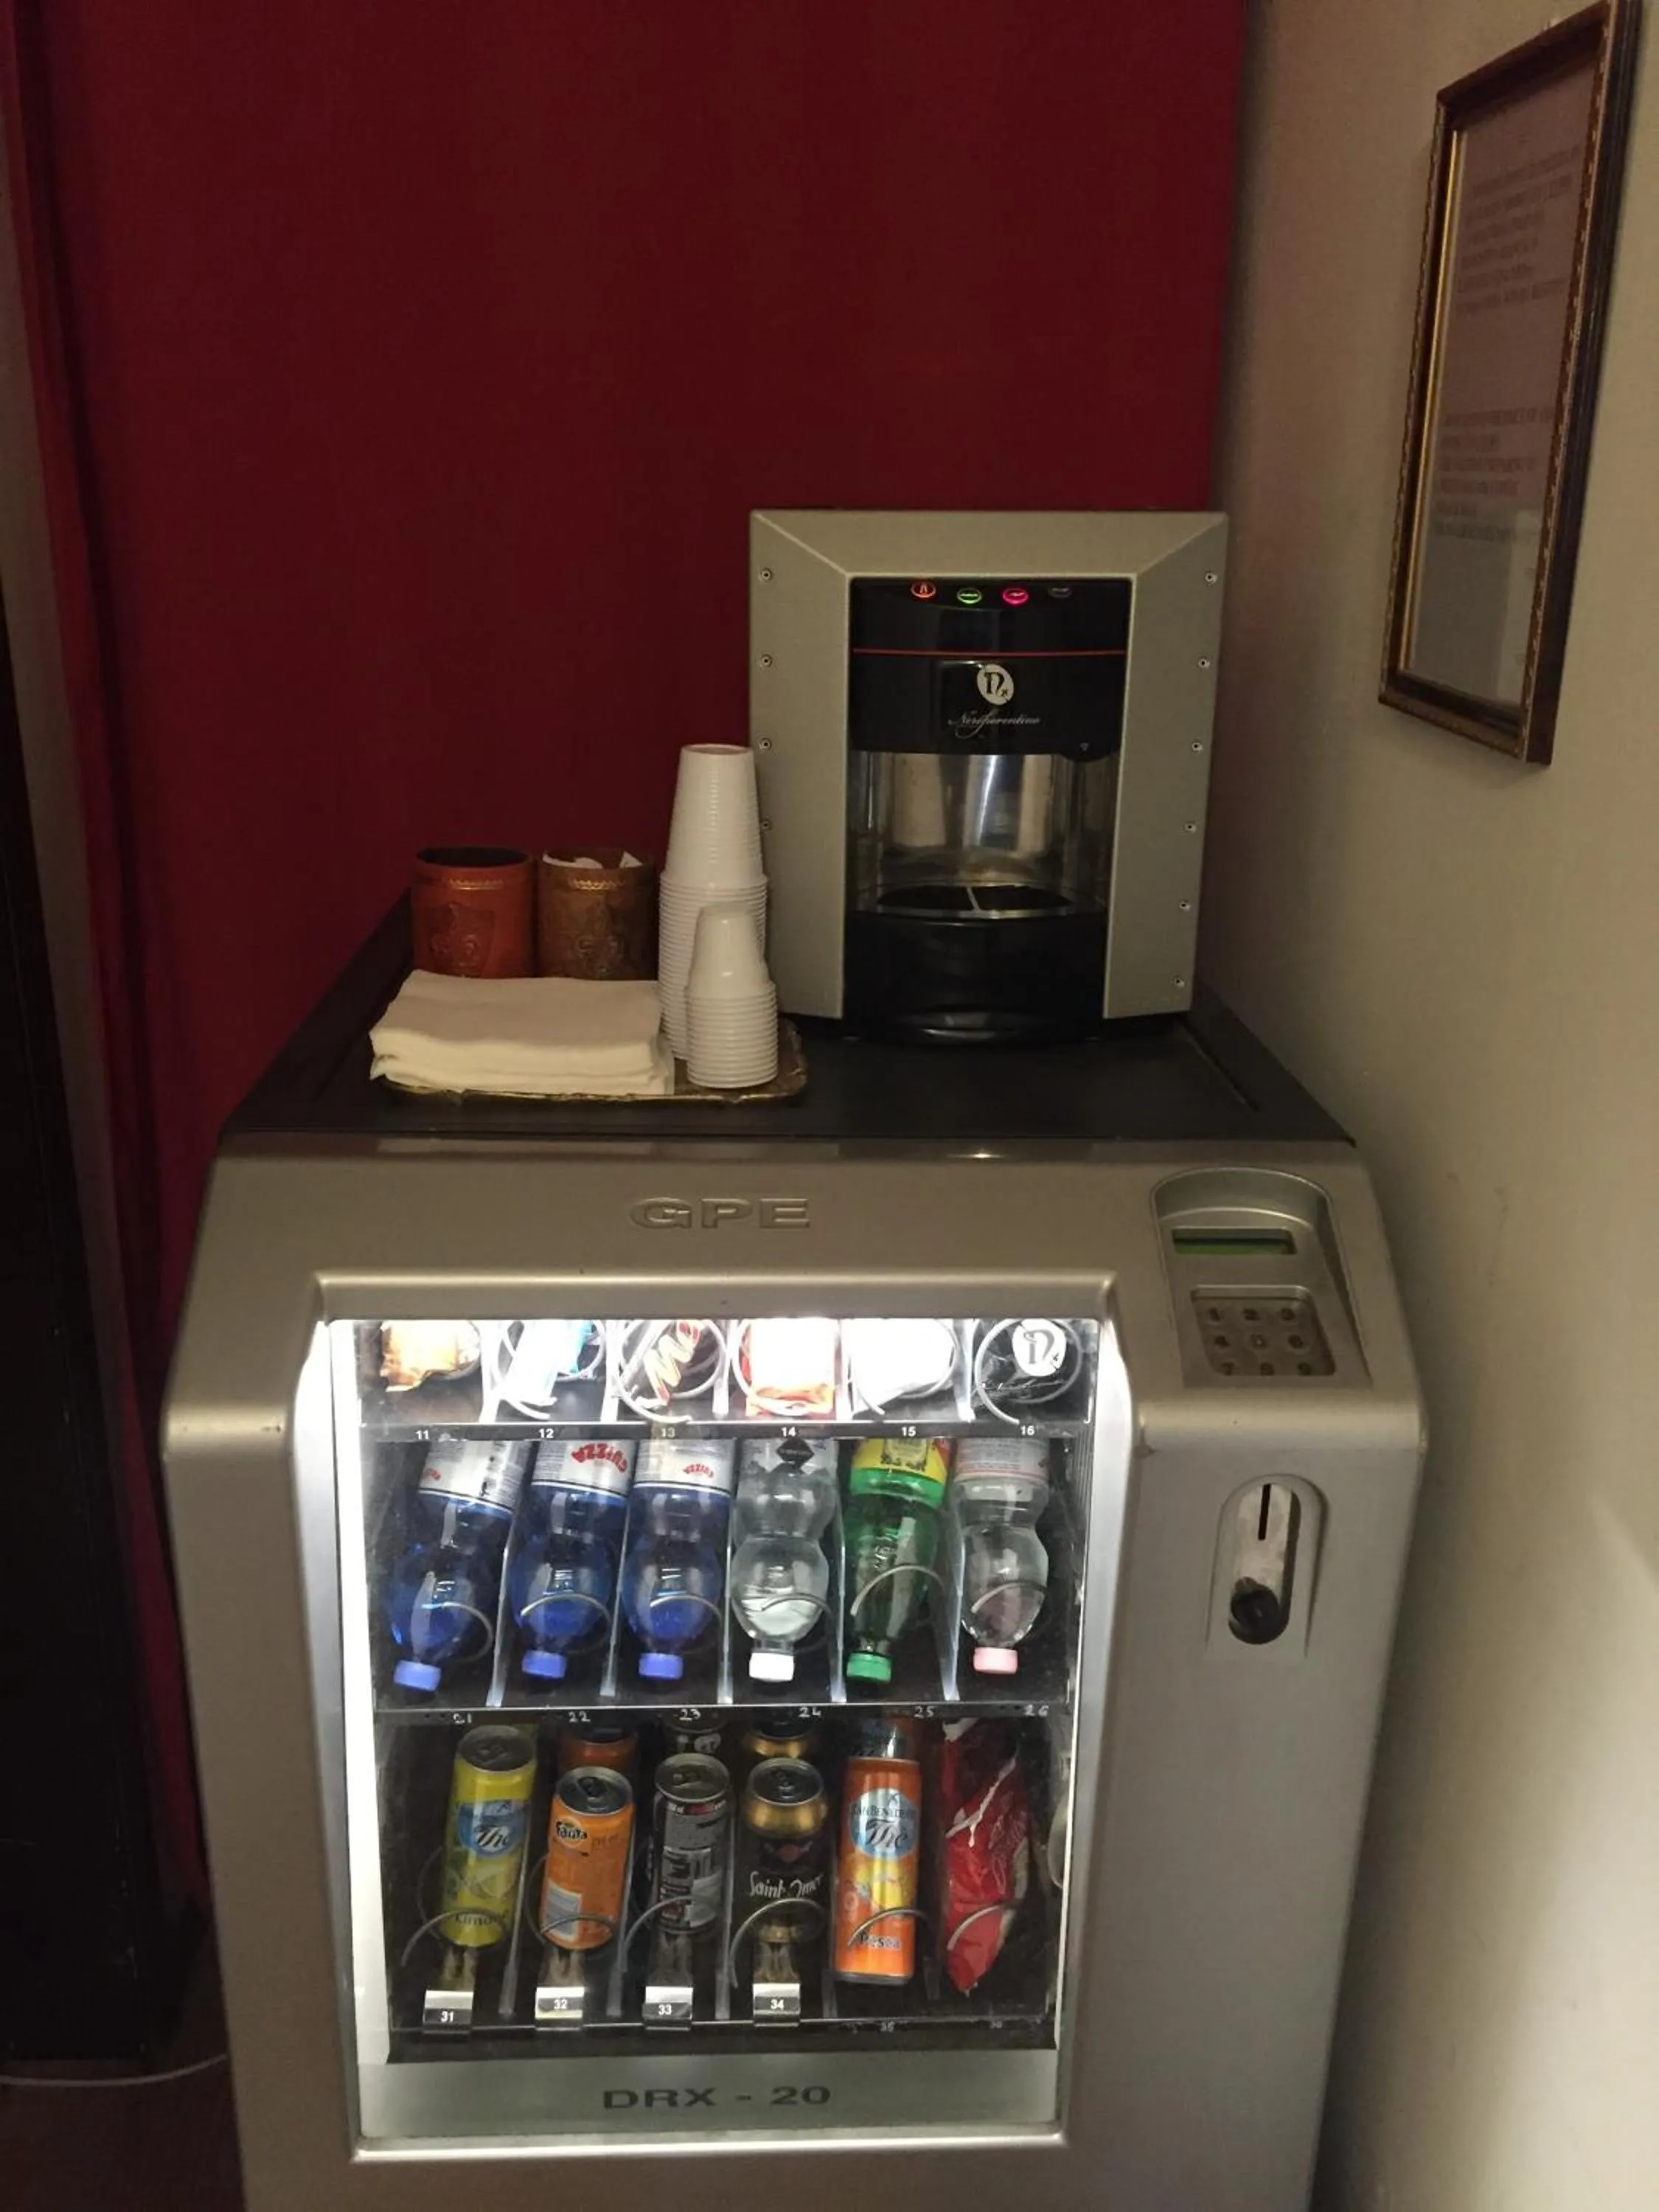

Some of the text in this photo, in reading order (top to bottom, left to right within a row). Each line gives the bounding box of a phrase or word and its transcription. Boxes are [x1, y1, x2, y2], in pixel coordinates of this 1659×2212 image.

[630, 1197, 810, 1229] GPE
[415, 1430, 429, 1440] 11
[538, 1428, 554, 1439] 12
[661, 1427, 675, 1438] 13
[782, 1427, 796, 1437] 14
[901, 1427, 917, 1436] 15
[1020, 1425, 1035, 1435] 16
[568, 1711, 591, 1722] 22
[680, 1708, 700, 1720] 23
[799, 1707, 821, 1718] 24
[914, 1707, 934, 1718] 25
[1025, 1705, 1048, 1717] 26
[556, 1821, 588, 1841] Fanta
[750, 1871, 786, 1899] Saint
[554, 1999, 567, 2010] 32
[658, 2004, 672, 2015] 33
[771, 1999, 785, 2010] 34
[441, 2011, 454, 2023] 31
[603, 2087, 717, 2109] DRX
[771, 2085, 831, 2104] 20
